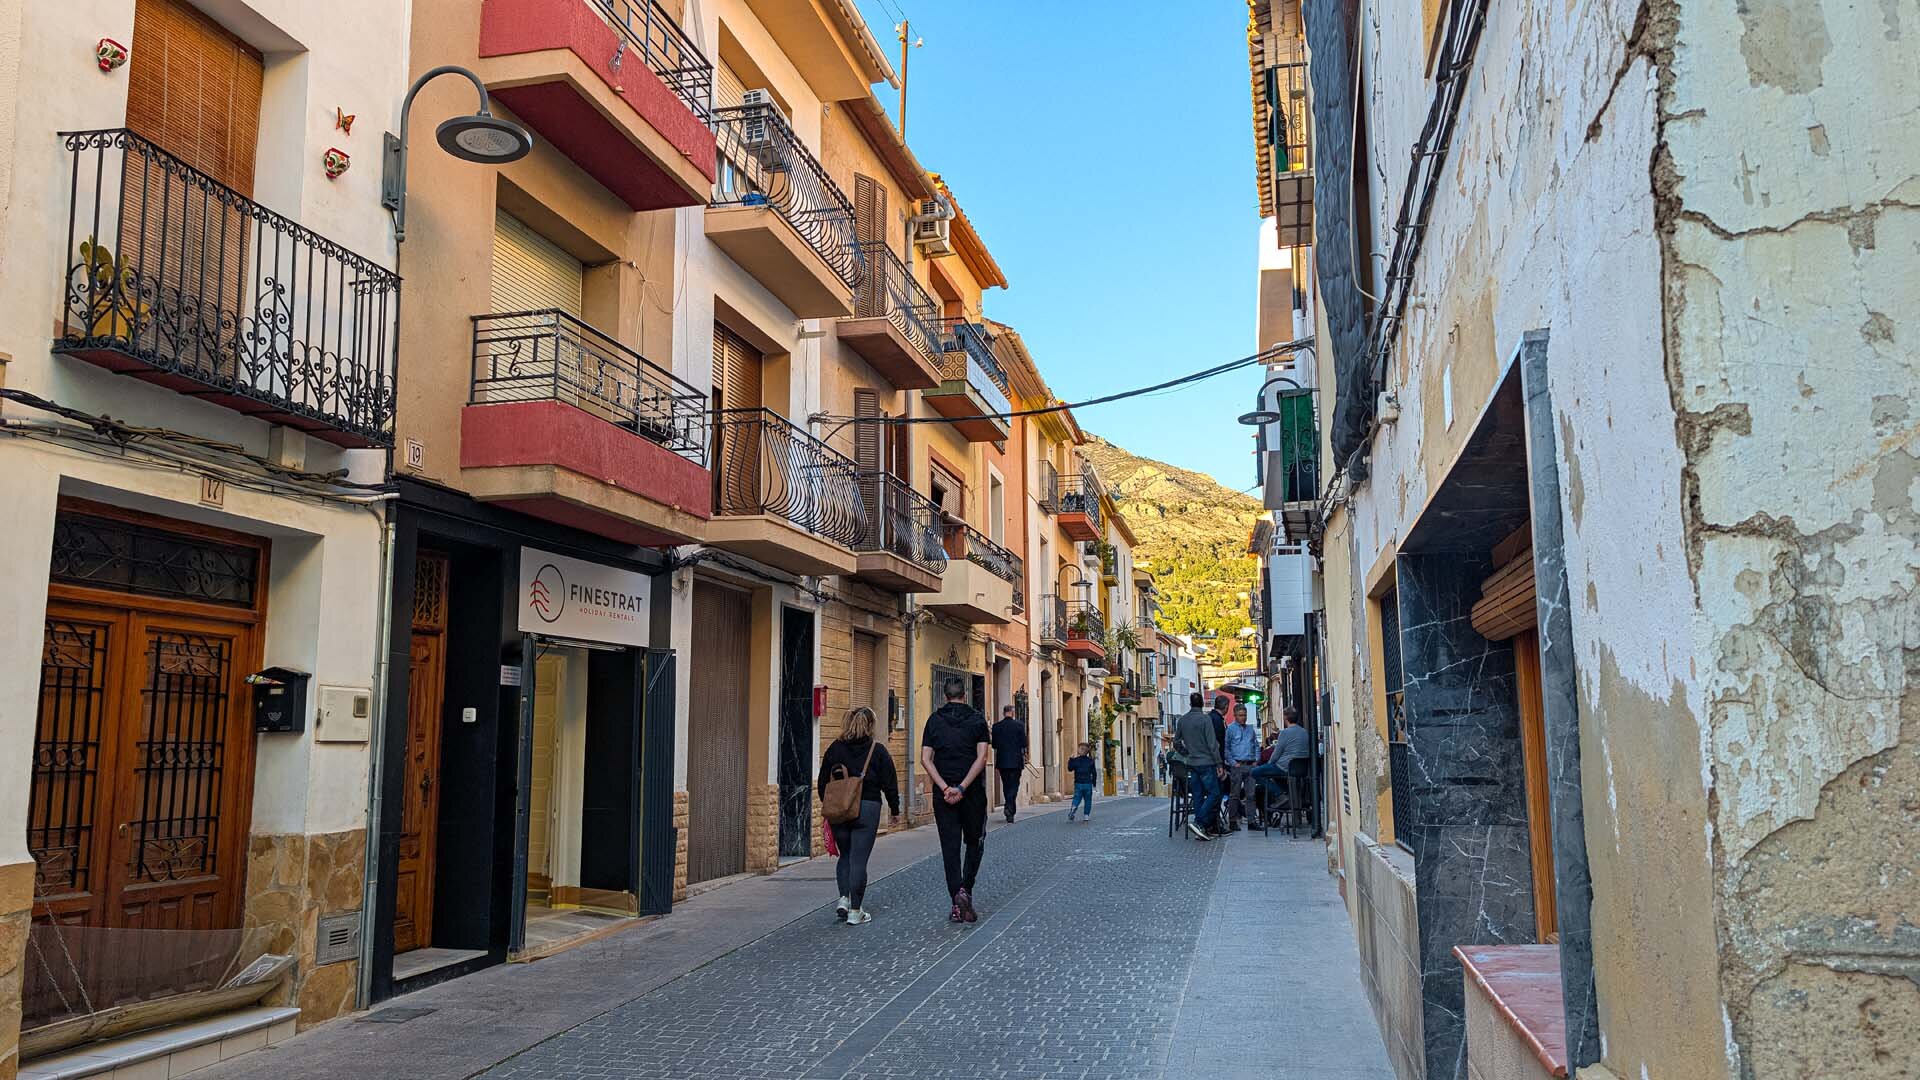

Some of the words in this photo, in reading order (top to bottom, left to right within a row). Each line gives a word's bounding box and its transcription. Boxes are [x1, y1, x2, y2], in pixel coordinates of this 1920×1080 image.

[411, 445, 421, 464] 19
[207, 478, 220, 500] 17
[570, 583, 643, 612] FINESTRAT
[579, 607, 606, 617] HOLIDAY
[609, 612, 635, 622] RENTALS
